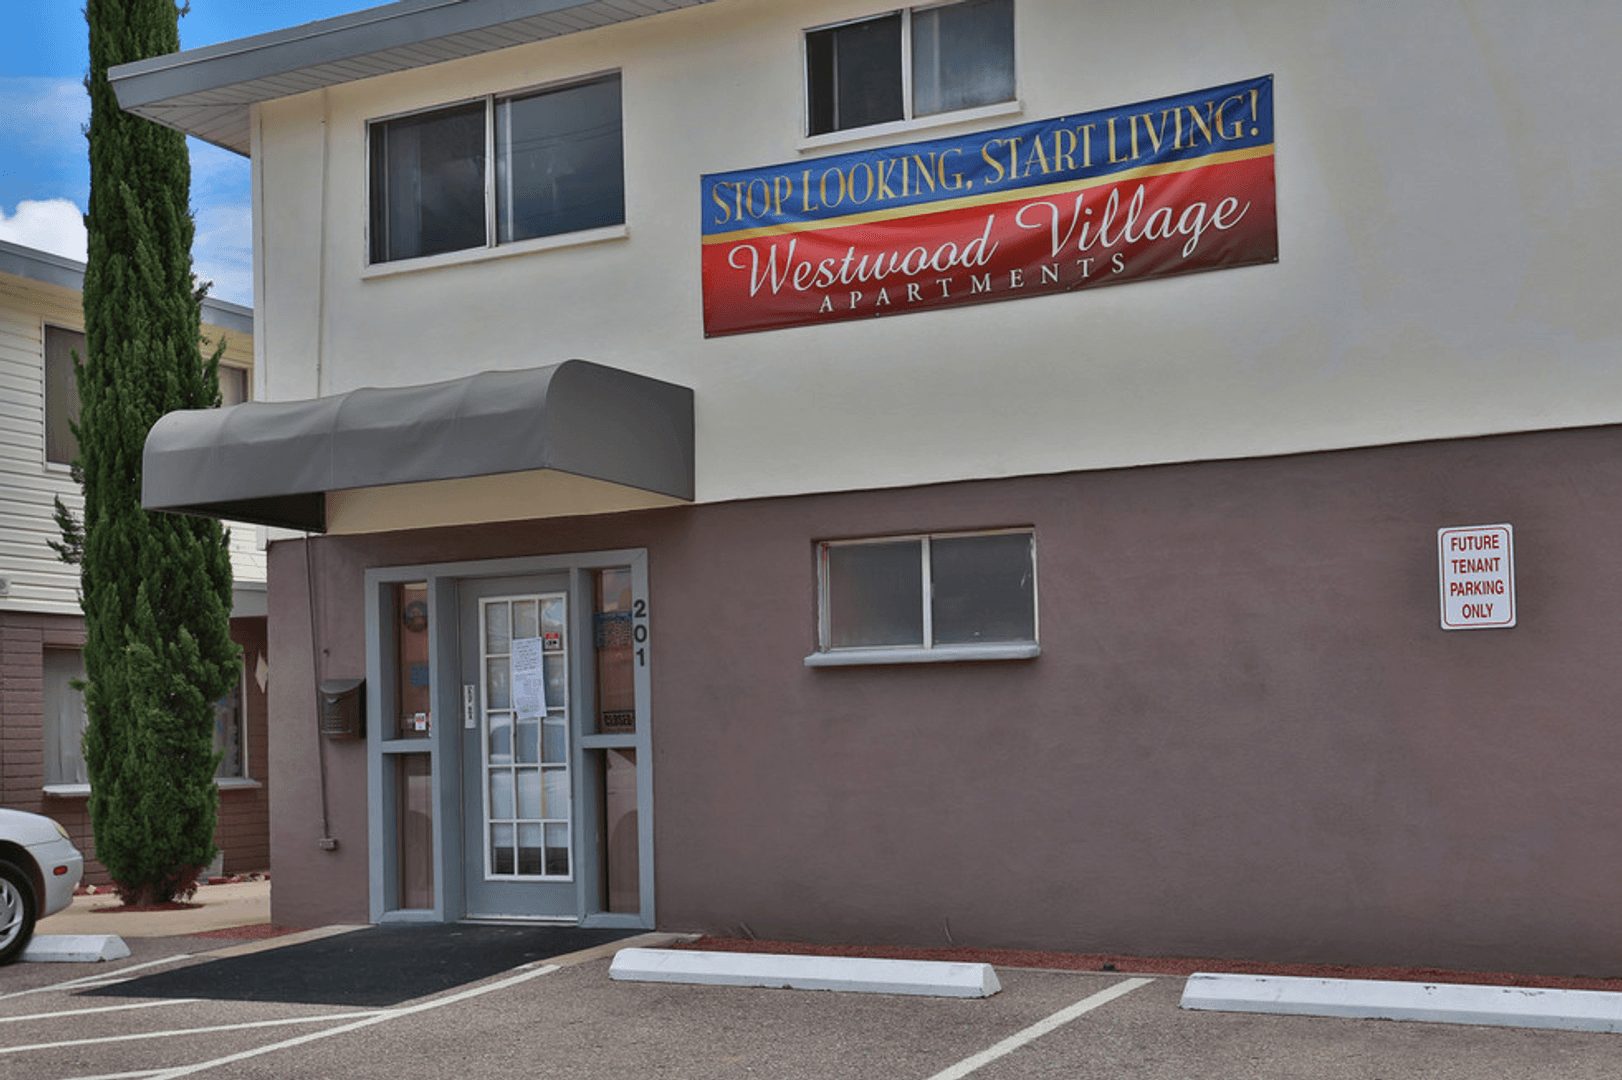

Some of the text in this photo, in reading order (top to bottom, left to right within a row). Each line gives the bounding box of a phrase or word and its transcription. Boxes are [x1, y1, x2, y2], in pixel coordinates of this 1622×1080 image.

[712, 89, 1260, 225] STOP LOOKING, START LIVING!
[728, 183, 1251, 298] Westwood Village
[818, 252, 1126, 313] APARTMENTS
[1450, 534, 1500, 552] FUTURE
[1451, 557, 1501, 574] TENANT
[1450, 579, 1505, 597] PARKING
[1461, 603, 1494, 619] ONLY
[633, 599, 648, 667] 201
